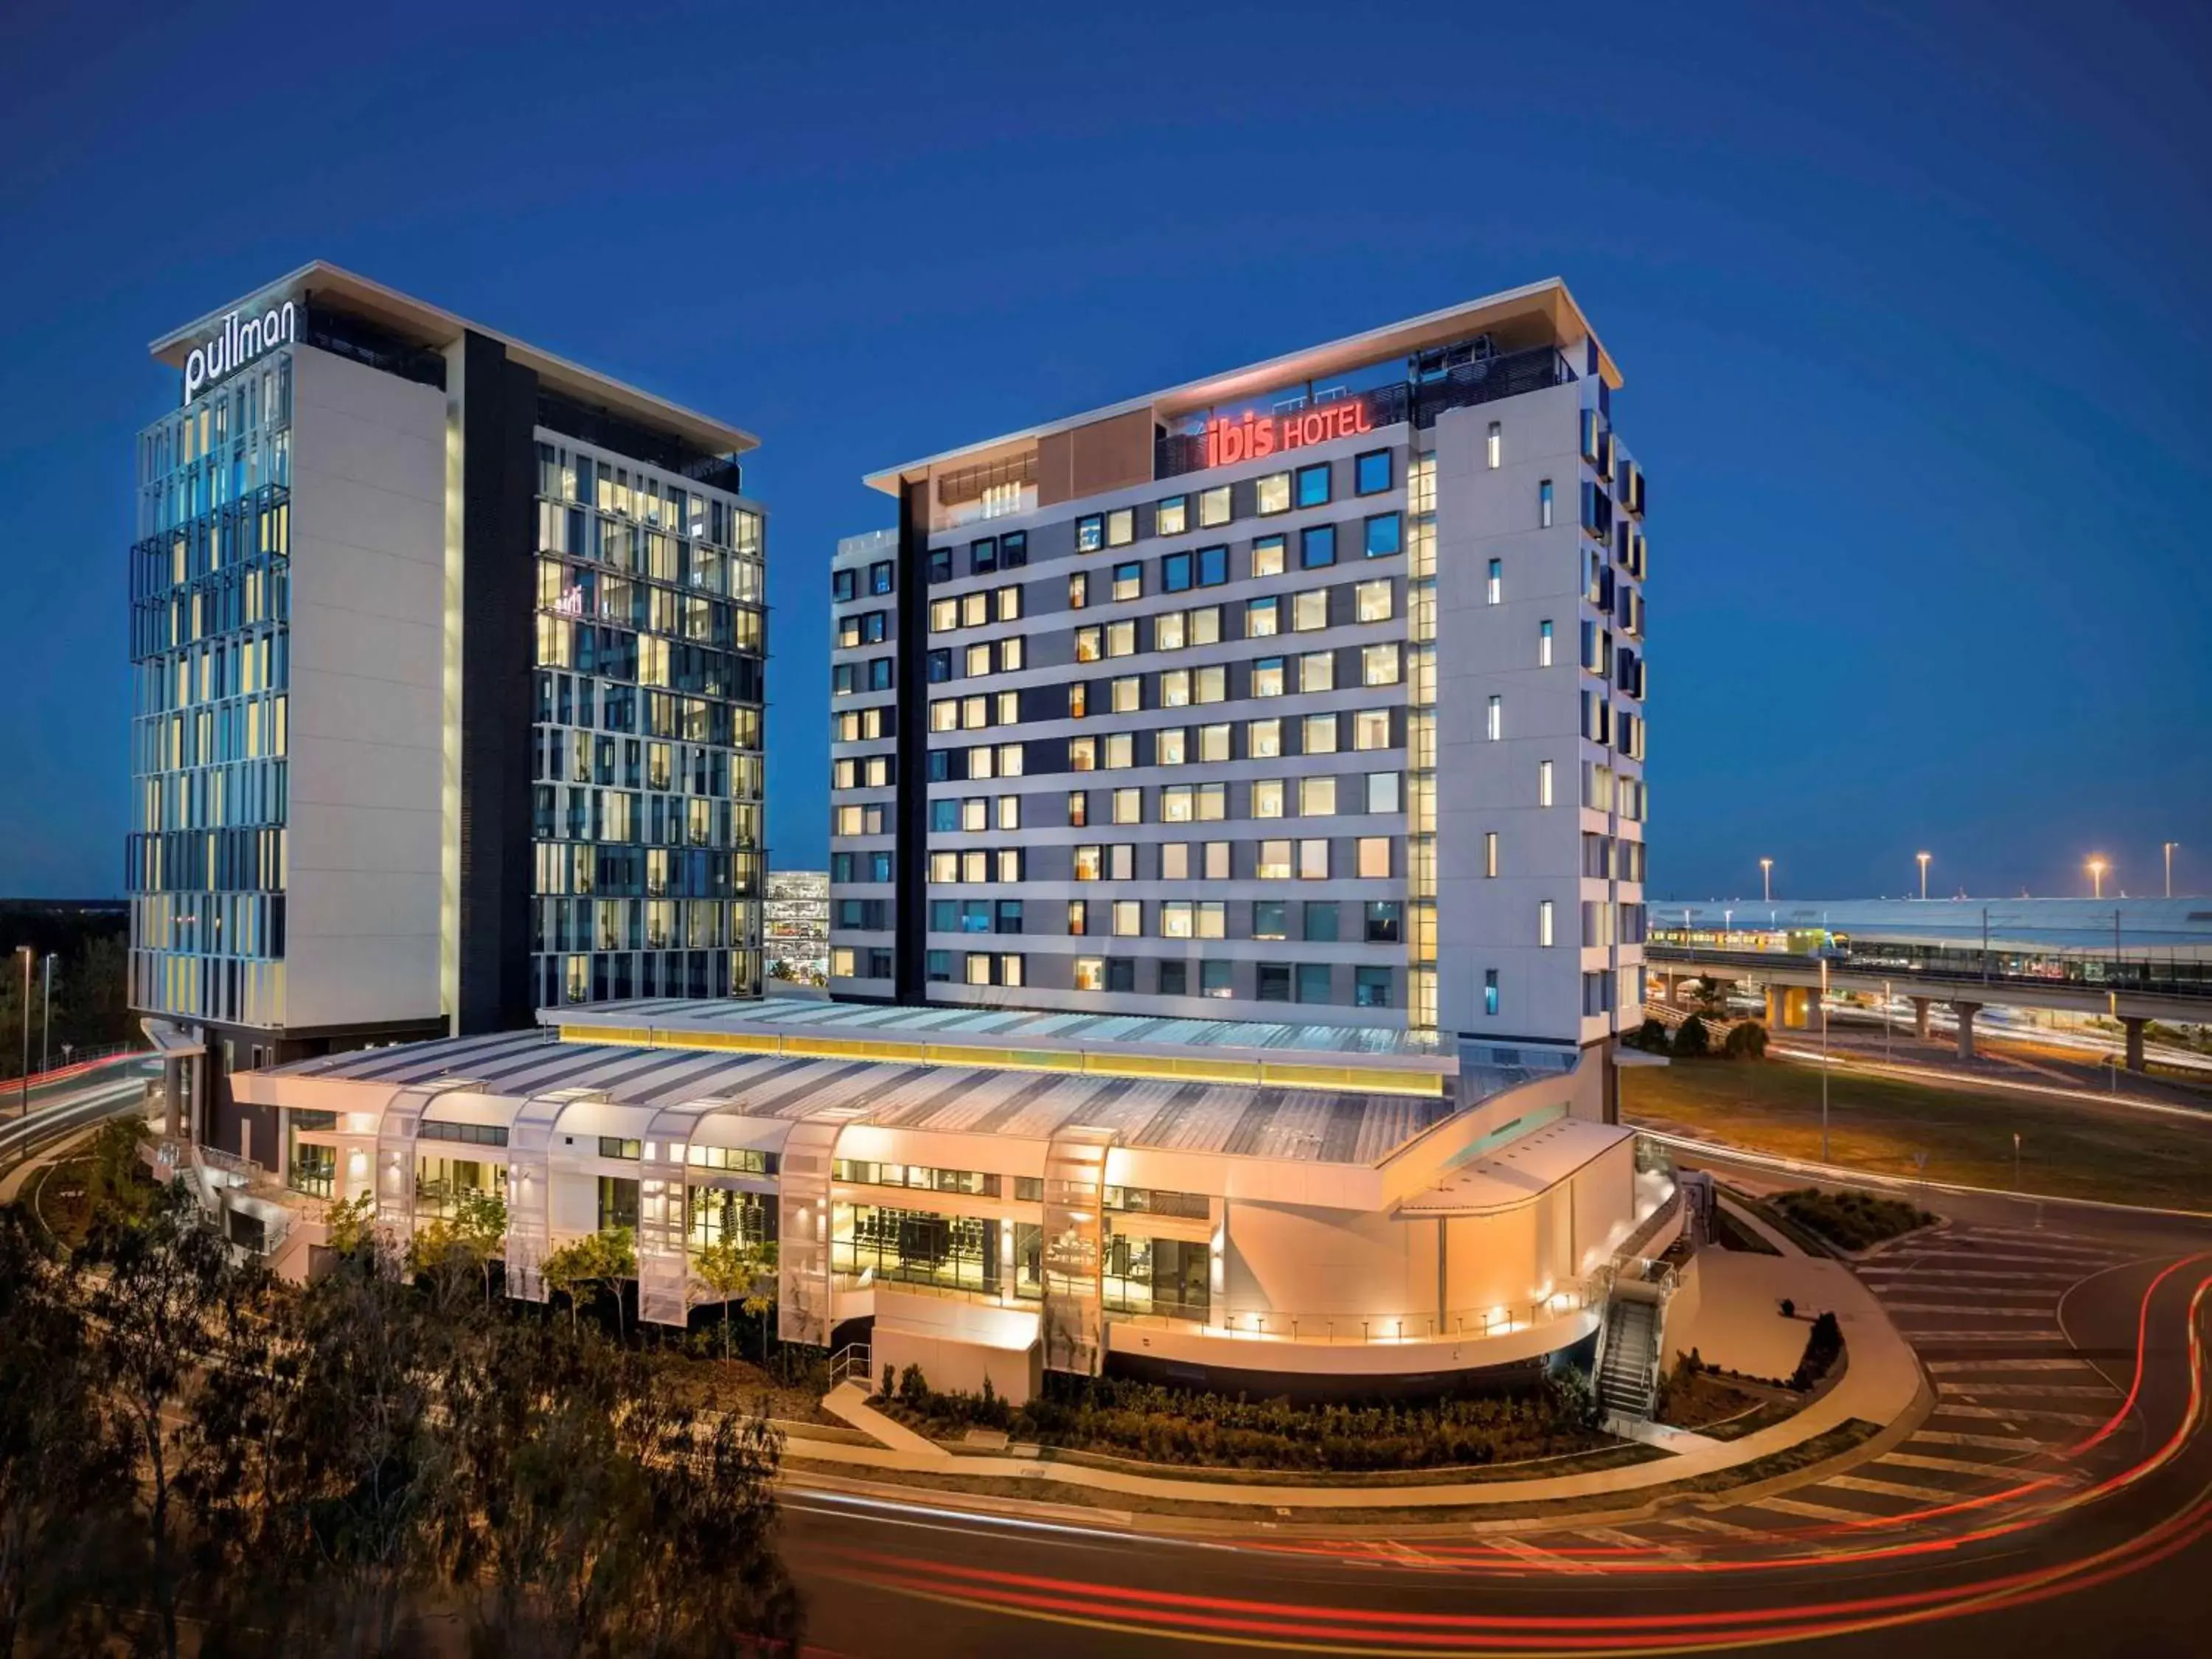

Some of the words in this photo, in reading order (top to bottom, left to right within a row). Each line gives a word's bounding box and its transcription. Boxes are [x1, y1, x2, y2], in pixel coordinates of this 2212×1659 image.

[186, 300, 294, 406] pullman
[1207, 411, 1273, 467] ibis
[1284, 402, 1371, 450] HOTEL
